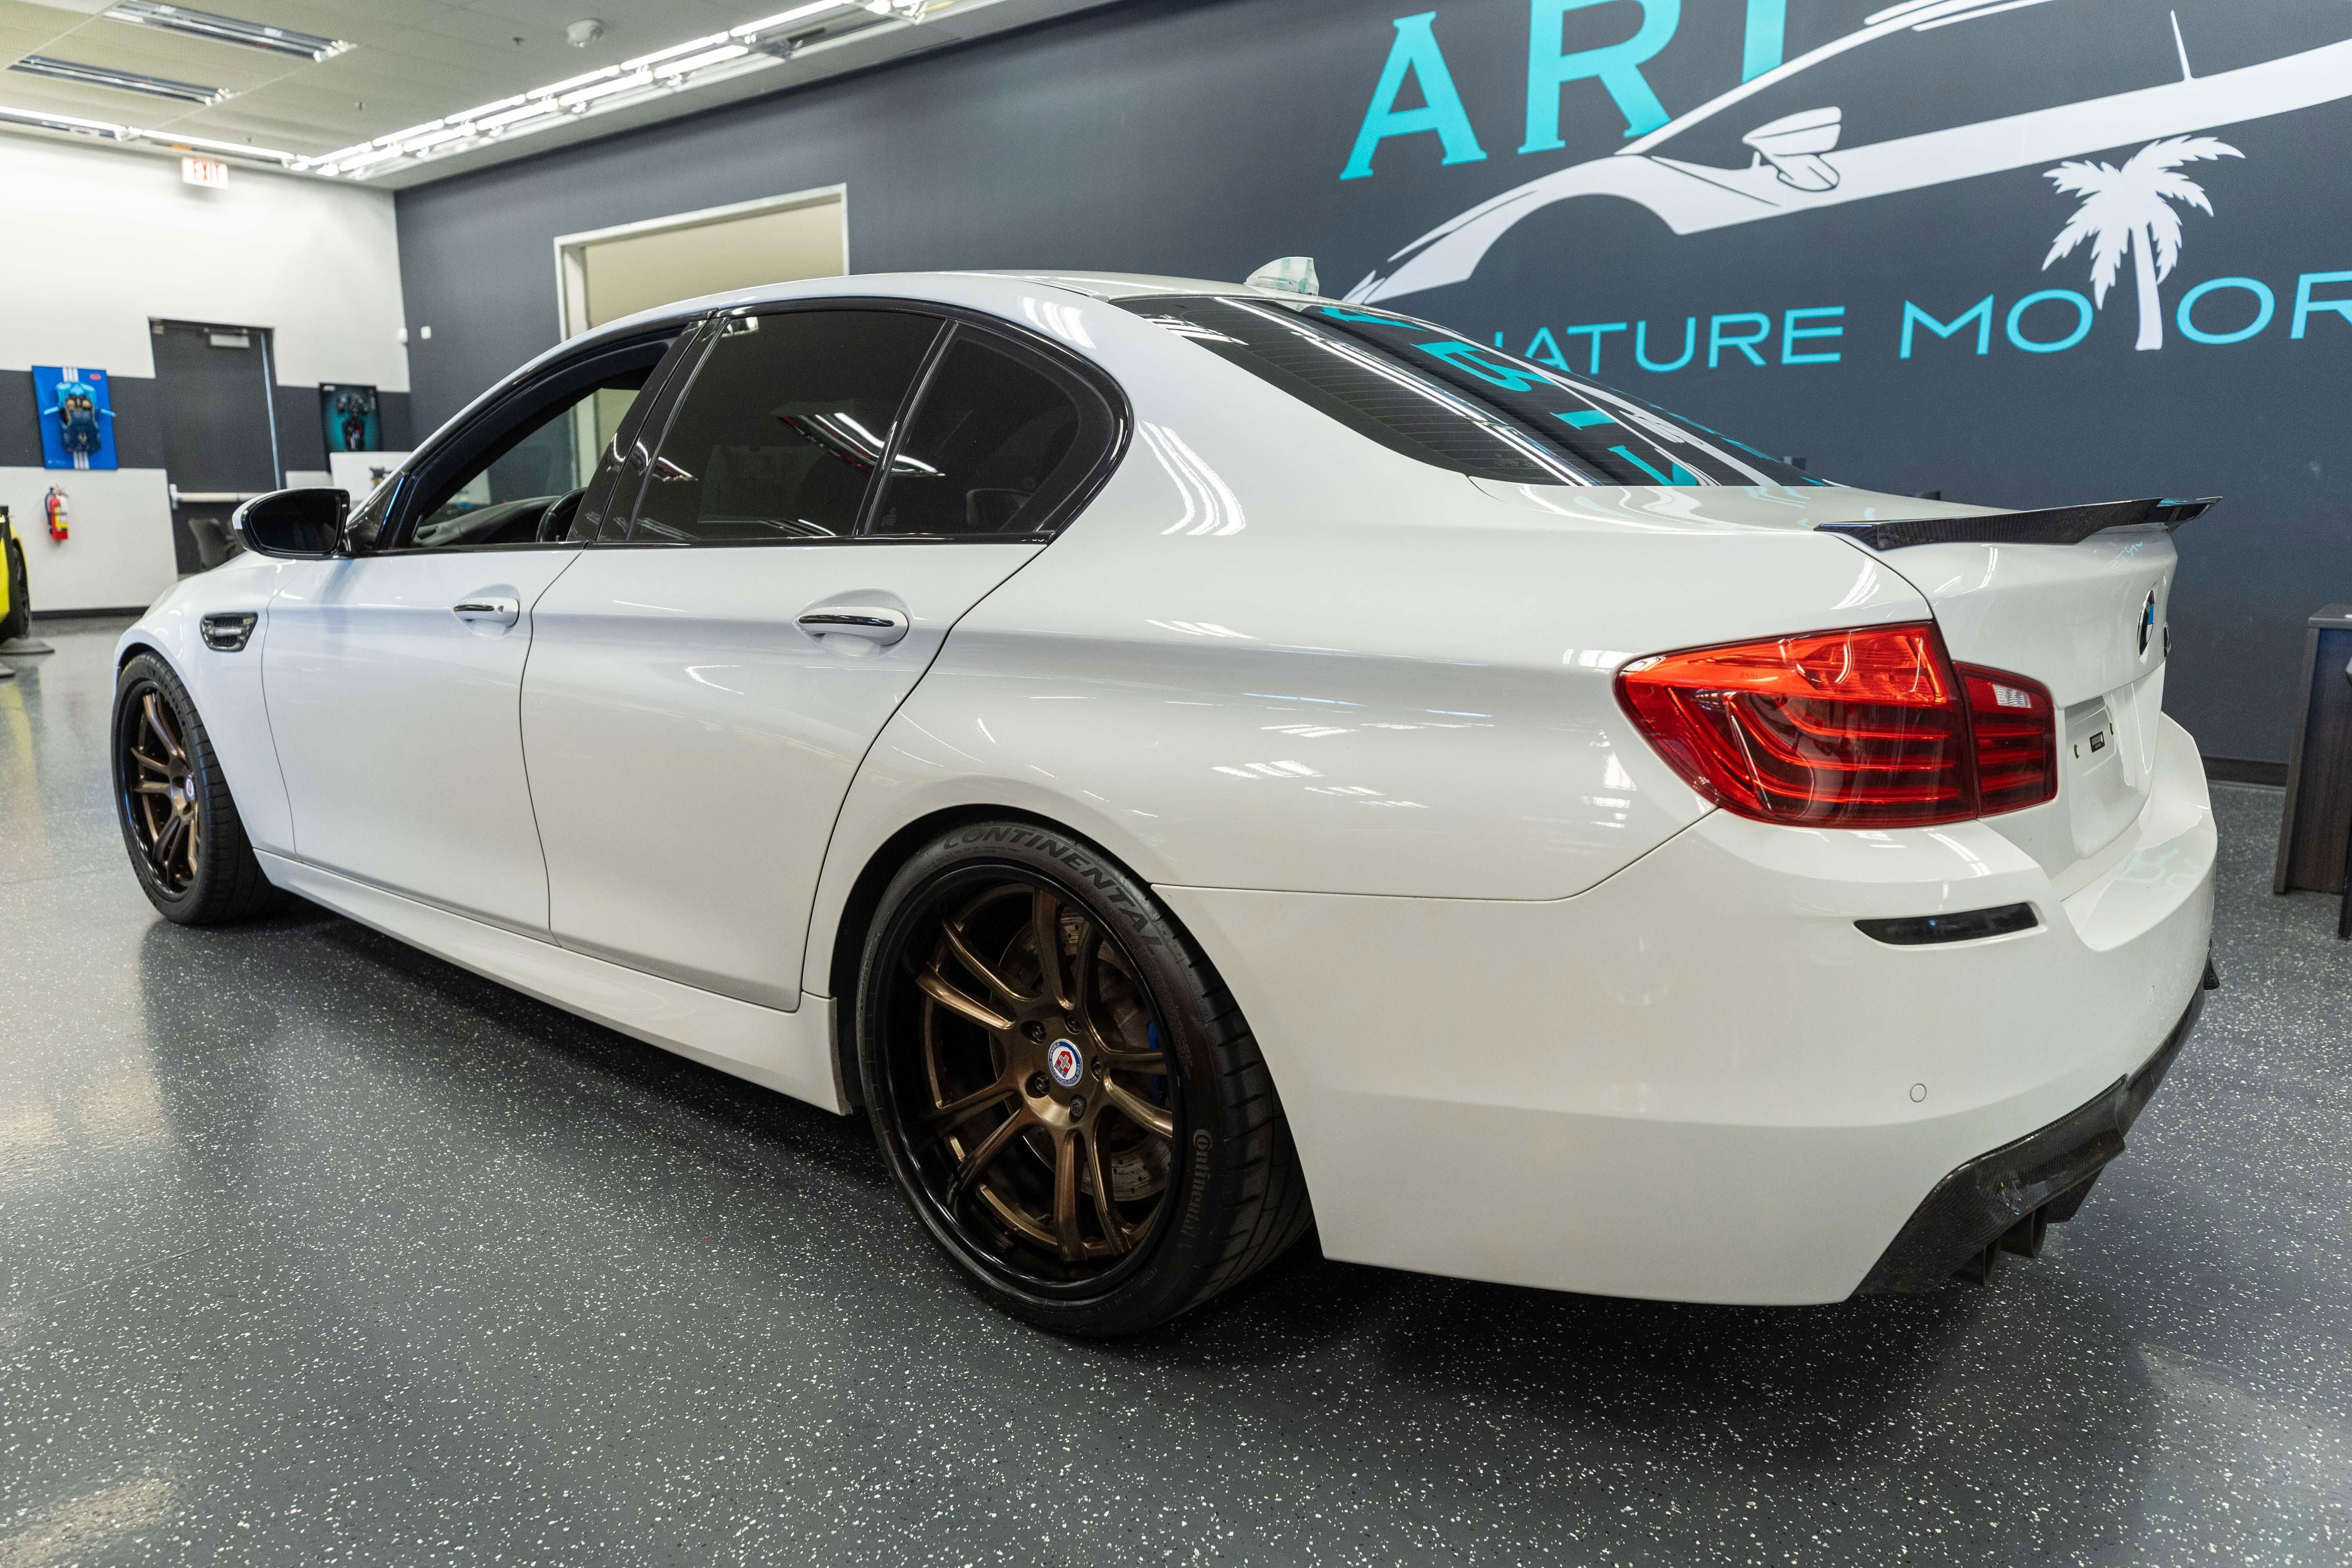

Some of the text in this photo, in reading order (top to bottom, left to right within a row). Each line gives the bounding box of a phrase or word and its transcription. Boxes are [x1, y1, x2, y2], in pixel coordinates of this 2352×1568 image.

[193, 158, 220, 184] EXIT
[1494, 305, 1846, 376] ATURE
[943, 826, 1167, 956] CONTINENTAL
[1180, 1128, 1213, 1238] Continental
